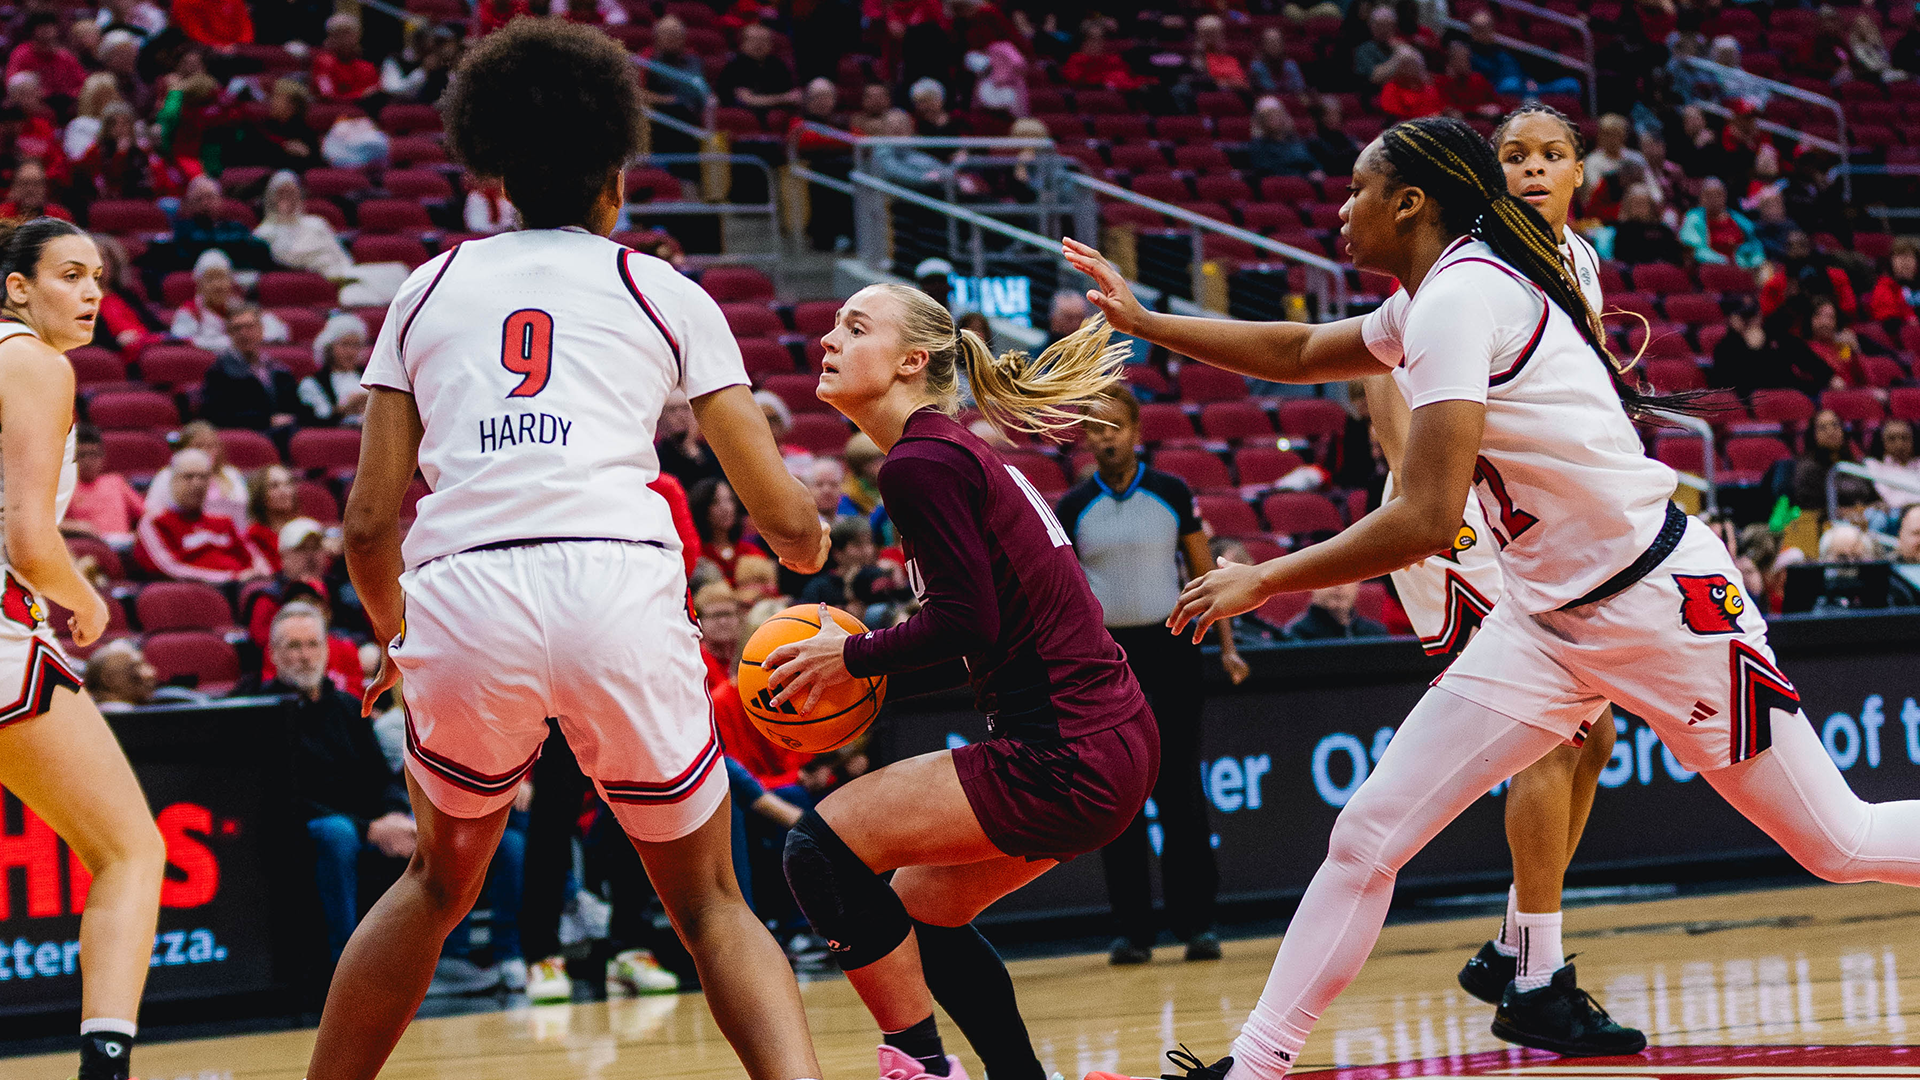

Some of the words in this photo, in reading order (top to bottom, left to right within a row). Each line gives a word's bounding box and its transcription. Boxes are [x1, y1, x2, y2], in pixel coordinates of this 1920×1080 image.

[500, 308, 554, 399] 9
[479, 412, 573, 453] HARDY
[1821, 694, 1886, 772] of
